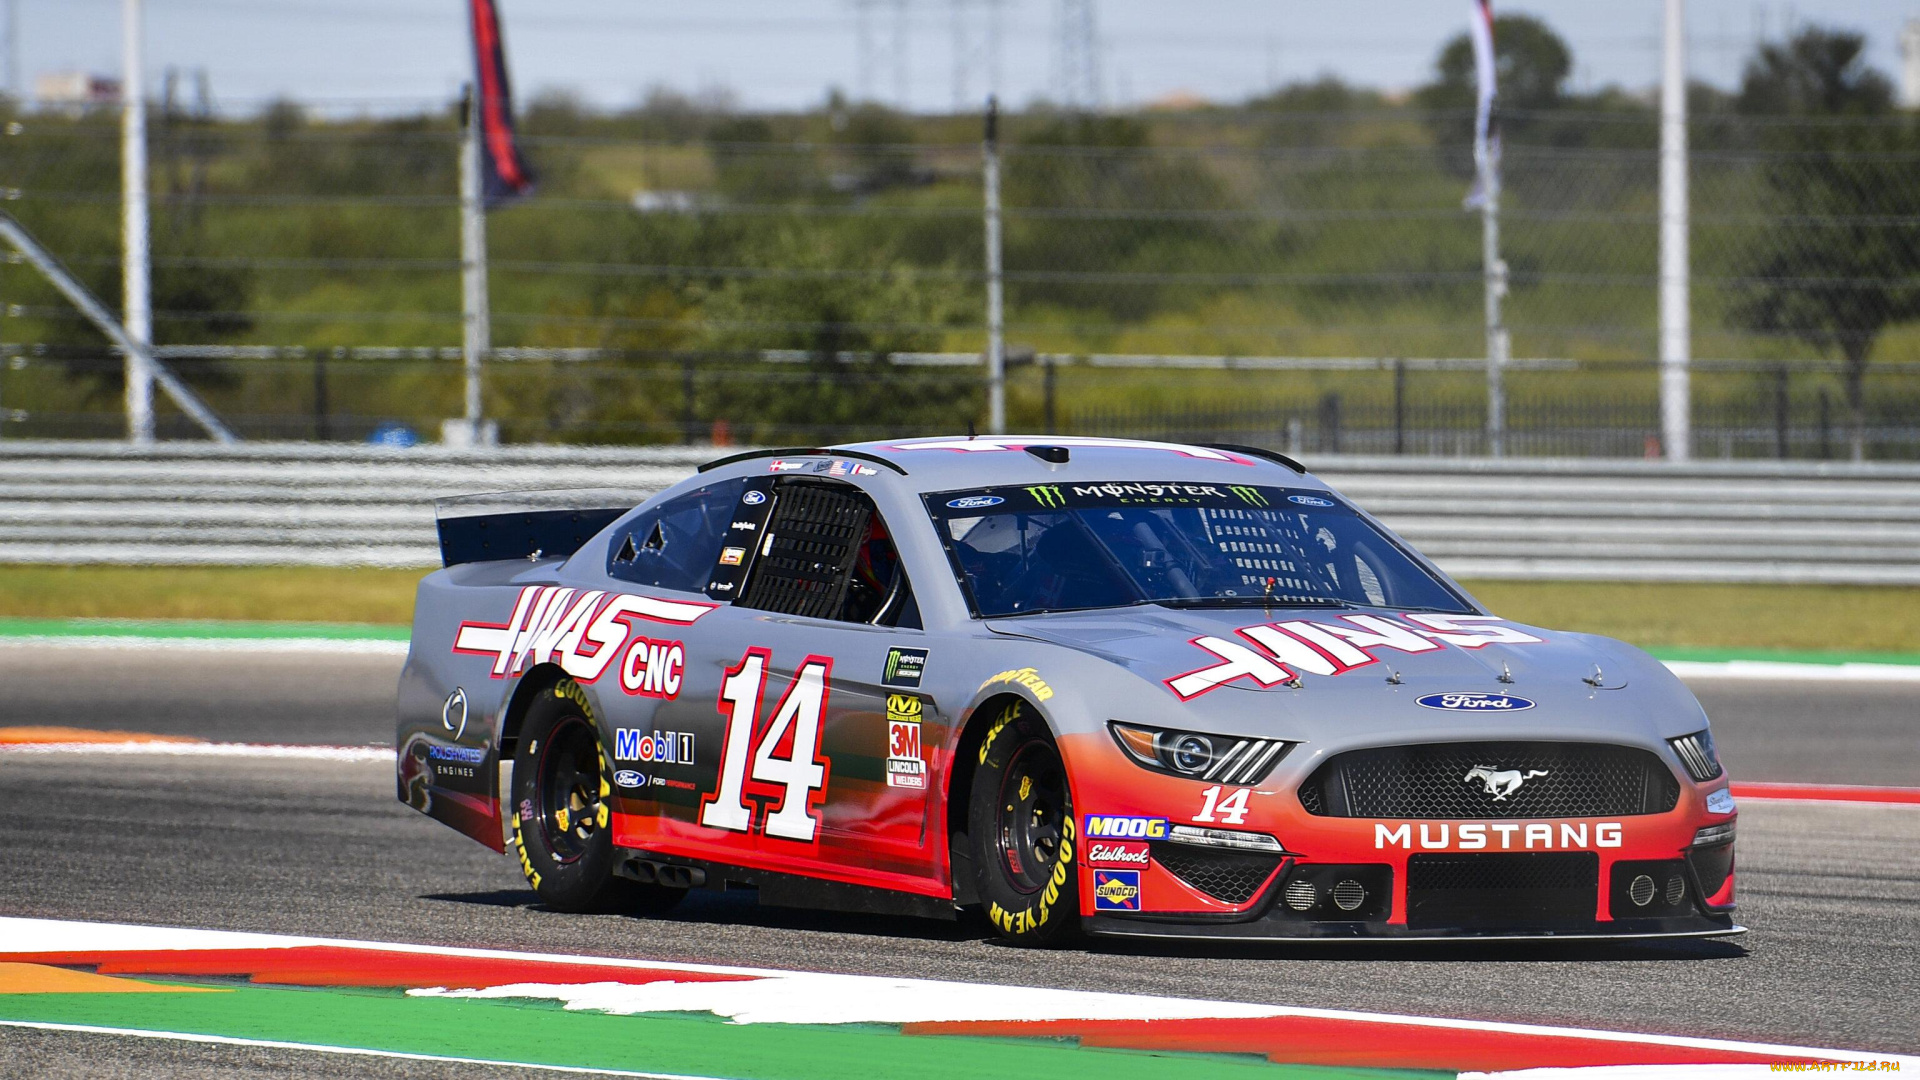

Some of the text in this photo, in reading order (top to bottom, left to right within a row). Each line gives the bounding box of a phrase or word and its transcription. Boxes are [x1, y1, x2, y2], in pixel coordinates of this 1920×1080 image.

[1072, 483, 1227, 498] MONSTER
[618, 636, 685, 701] CNC
[1441, 695, 1513, 708] Ford
[615, 728, 691, 763] Mobil 1
[700, 647, 833, 844] 14
[891, 724, 919, 758] 3M
[437, 765, 474, 777] ENGINES
[888, 760, 919, 774] LINCOLN
[896, 775, 923, 787] WELDERS
[1191, 785, 1251, 824] 14
[1087, 817, 1166, 837] MOOG
[1375, 822, 1622, 849] MUSTANG
[1089, 845, 1149, 864] Edelbrock
[1097, 887, 1136, 897] SUNOCO
